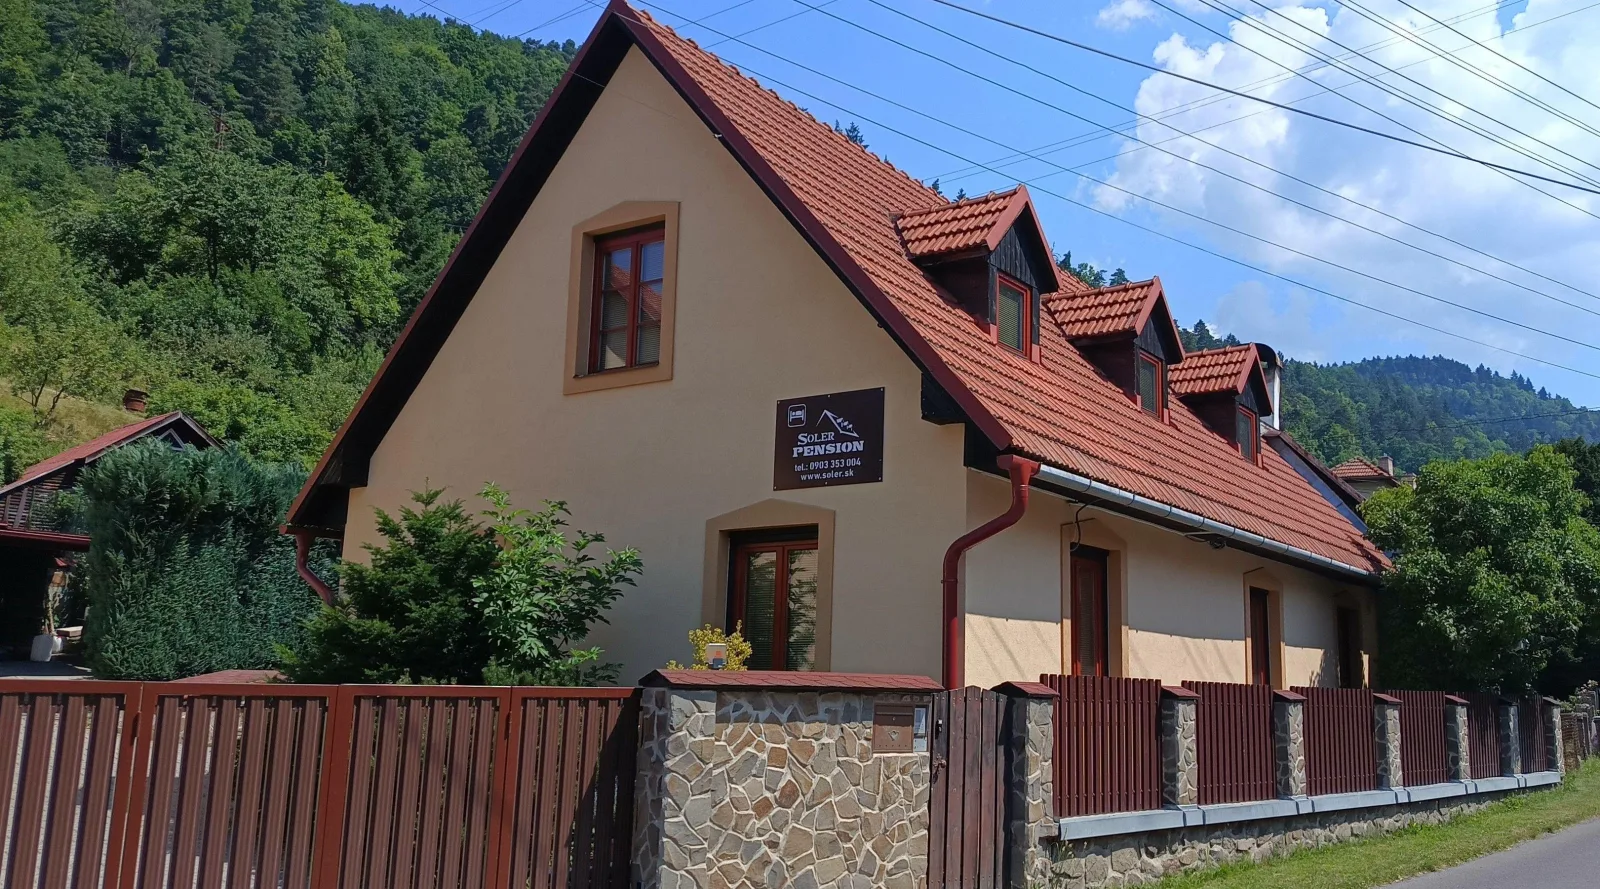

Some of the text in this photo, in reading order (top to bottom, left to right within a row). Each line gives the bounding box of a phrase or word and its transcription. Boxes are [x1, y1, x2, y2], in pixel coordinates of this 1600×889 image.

[792, 440, 865, 458] PENSION
[794, 457, 861, 472] tel.: 0903 353 004
[800, 468, 854, 480] www.soler.sk
